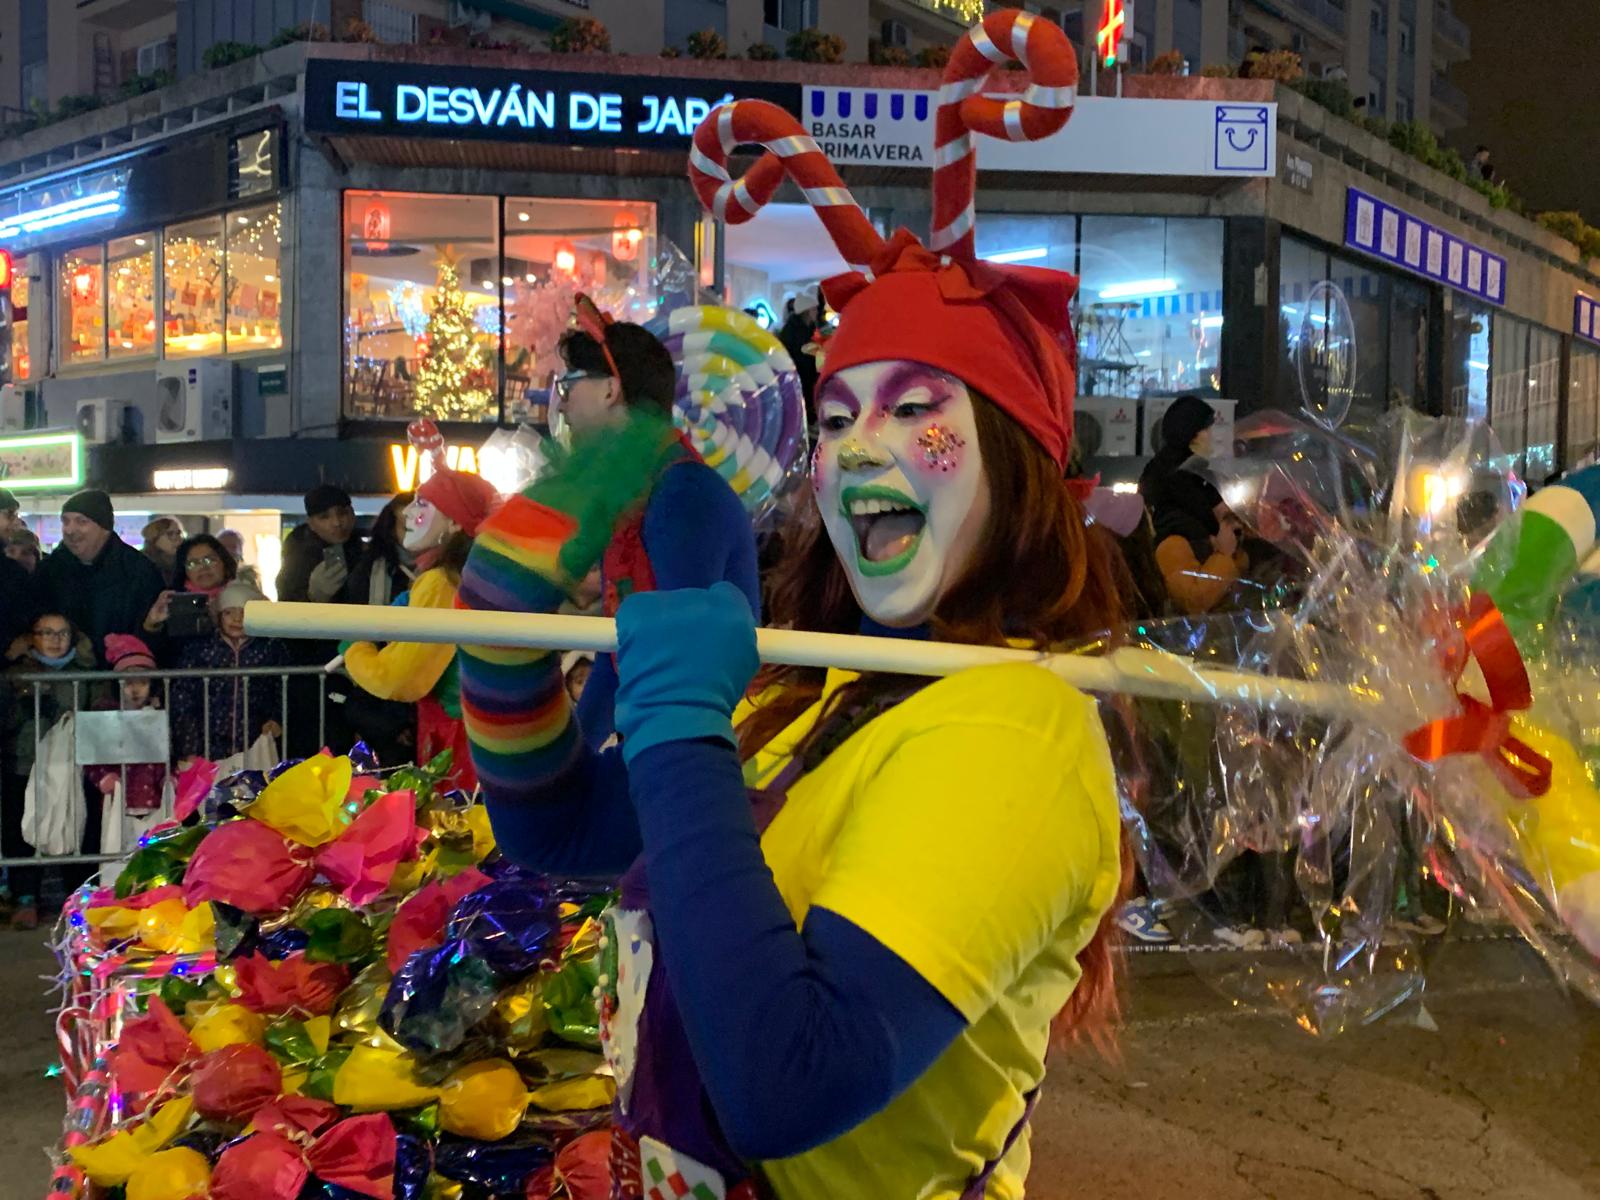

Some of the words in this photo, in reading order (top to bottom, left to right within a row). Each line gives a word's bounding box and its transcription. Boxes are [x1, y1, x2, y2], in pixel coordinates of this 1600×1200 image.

[335, 81, 381, 120] EL
[396, 84, 555, 130] DESVÁN
[569, 91, 623, 132] DE
[637, 93, 734, 135] JAP
[812, 122, 876, 139] BASAR
